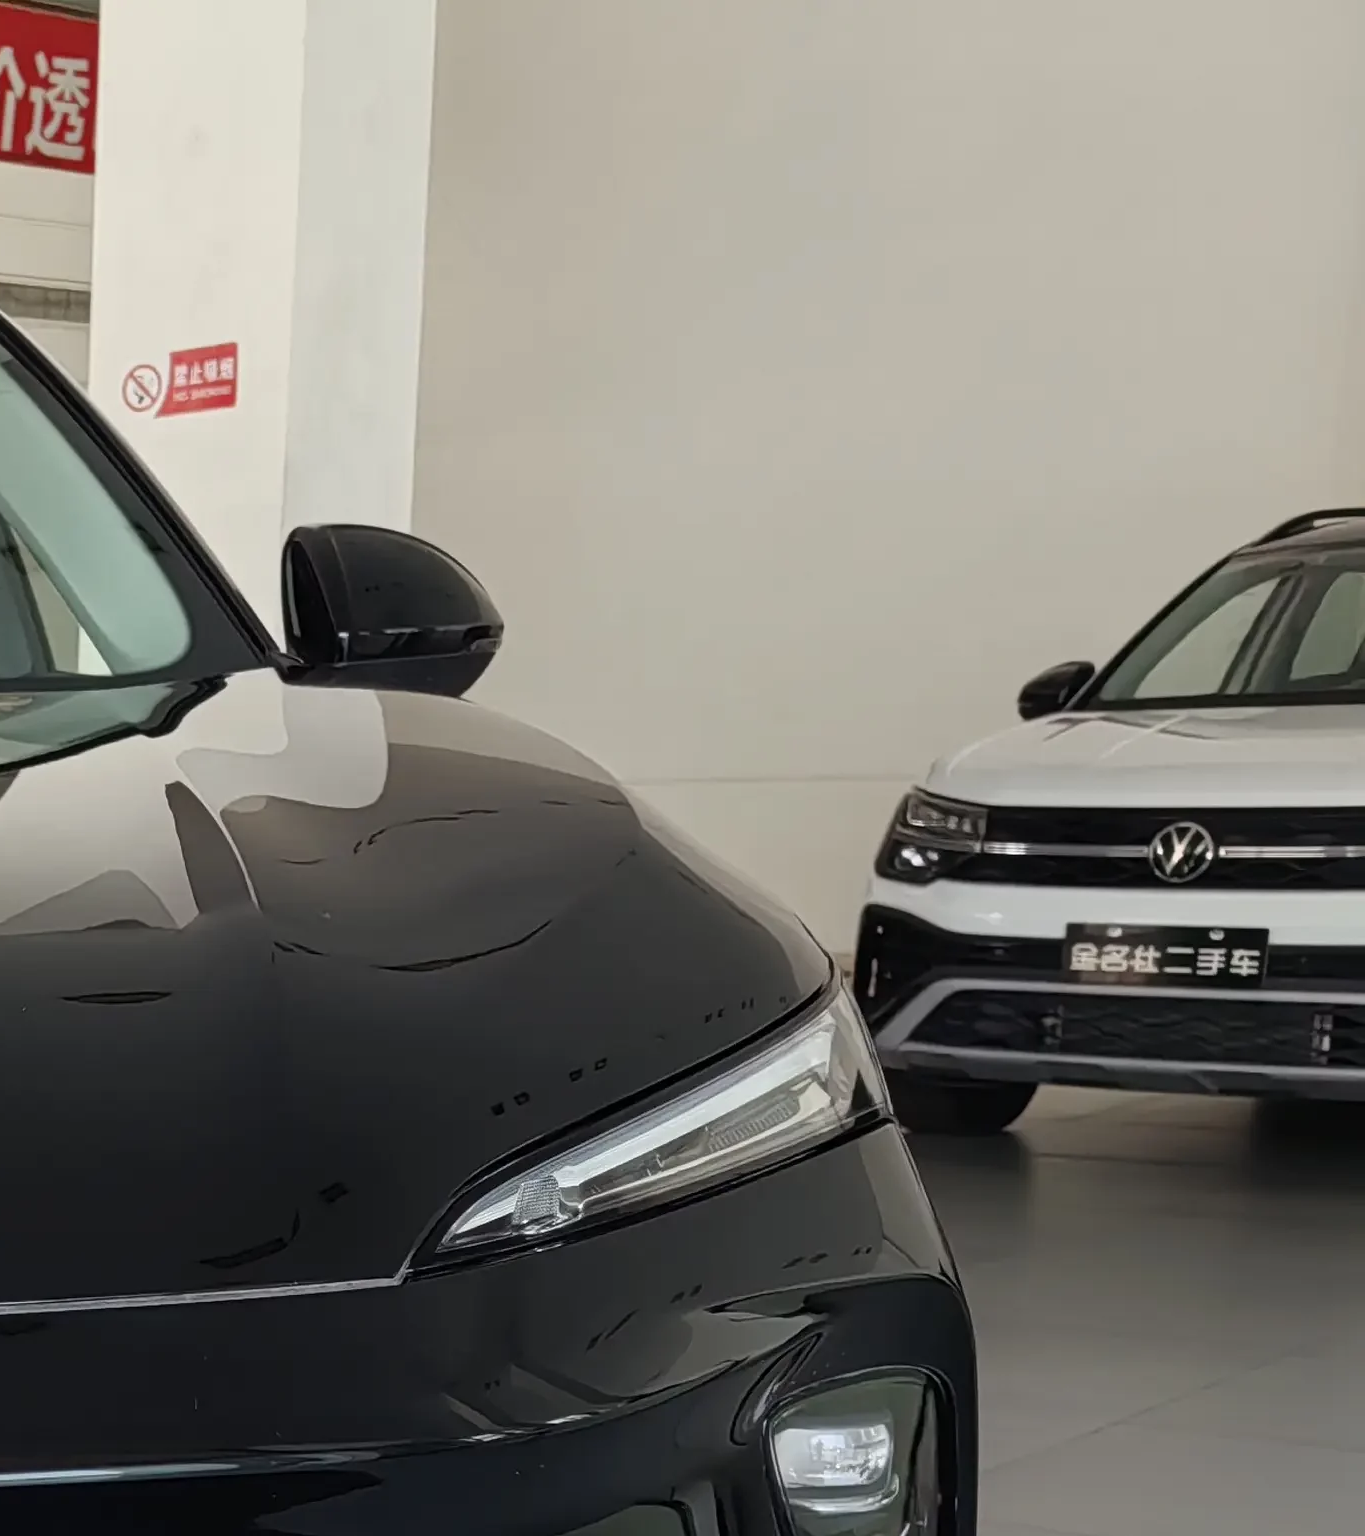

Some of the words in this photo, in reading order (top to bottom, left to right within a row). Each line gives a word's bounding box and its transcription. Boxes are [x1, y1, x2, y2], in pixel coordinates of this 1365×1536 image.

[1070, 942, 1261, 976] 金名仕二手车
